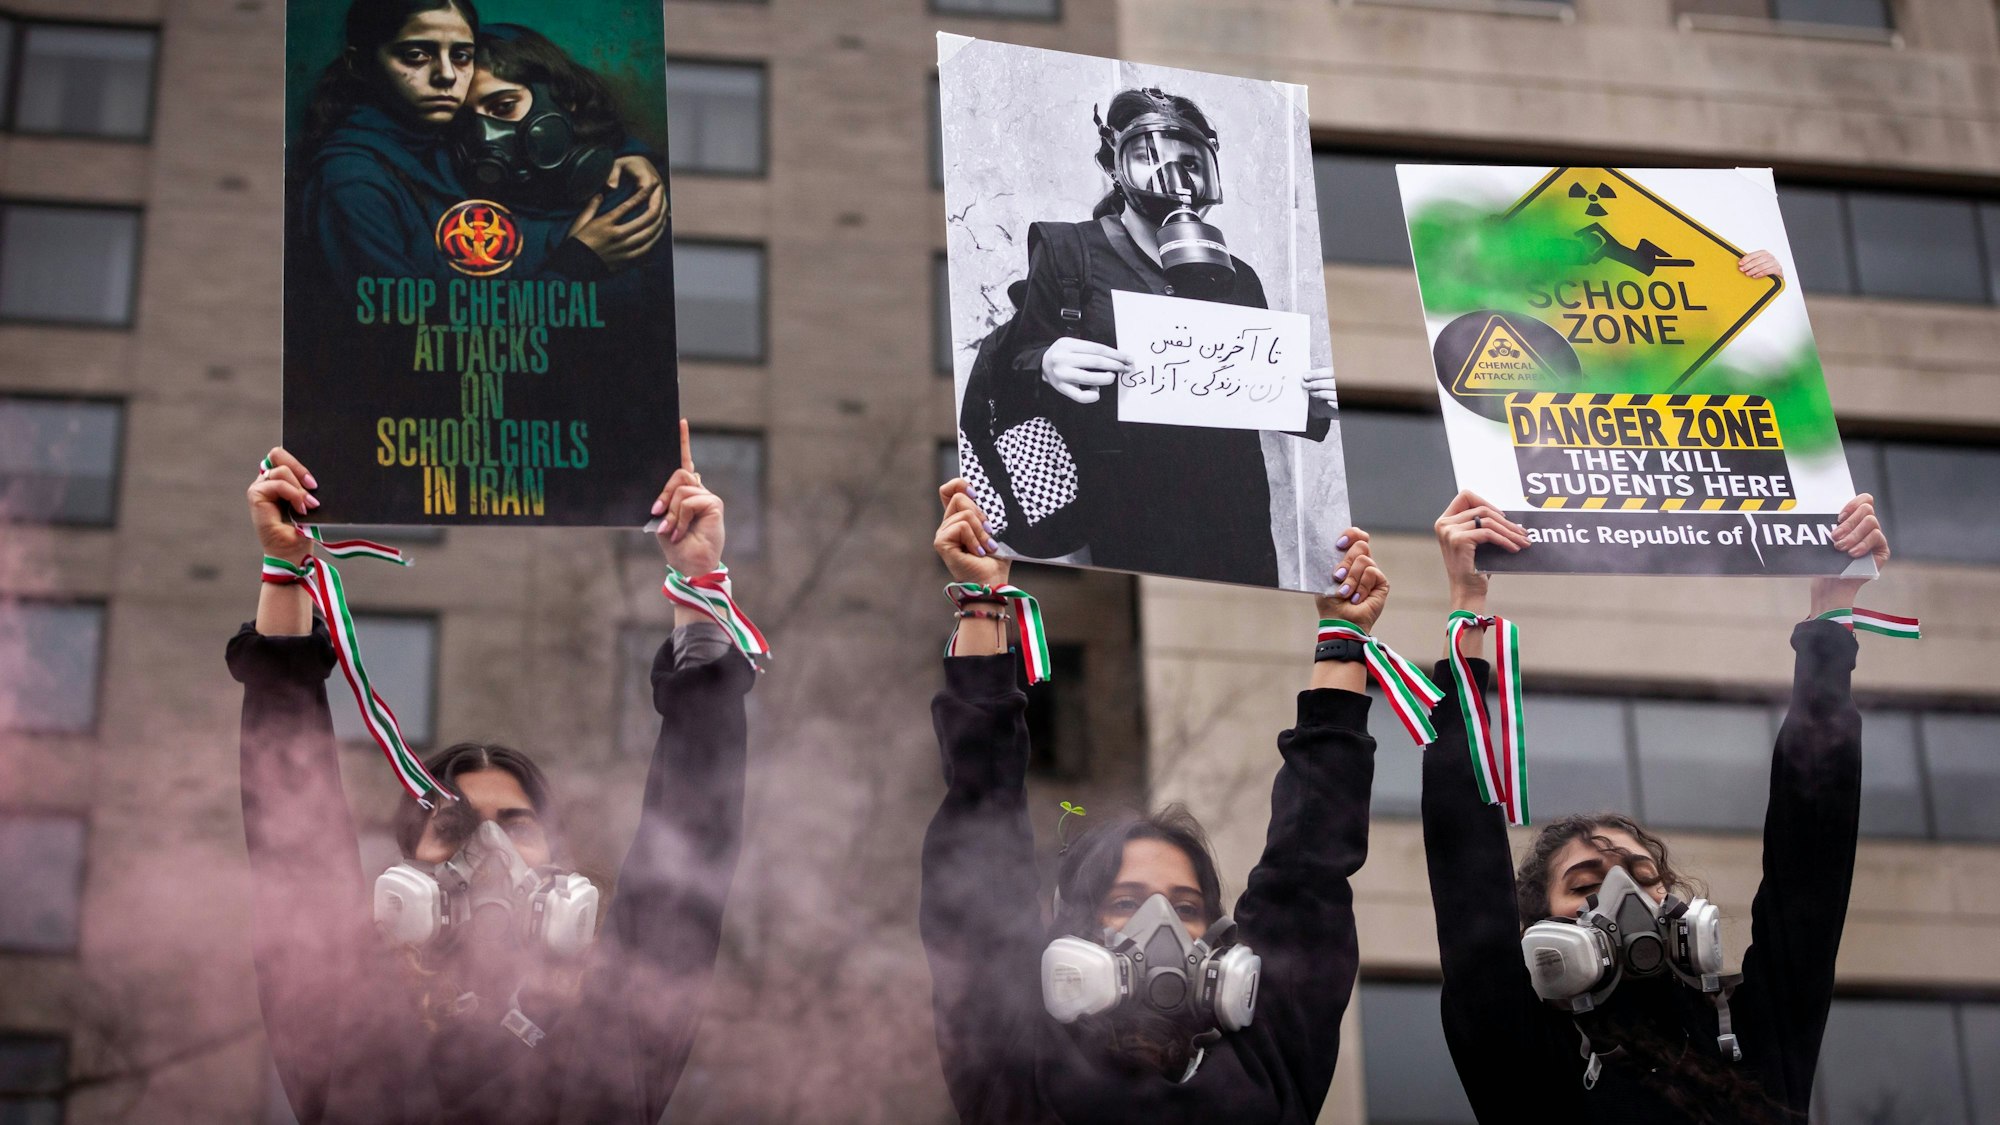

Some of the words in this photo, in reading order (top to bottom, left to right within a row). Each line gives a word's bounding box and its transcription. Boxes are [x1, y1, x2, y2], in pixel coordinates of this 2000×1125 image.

[357, 276, 436, 325] STOP
[449, 278, 606, 328] CHEMICAL
[1526, 280, 1708, 311] SCHOOL
[1199, 327, 1272, 363] آخرین
[1562, 313, 1685, 345] ZONE
[413, 325, 549, 374] ATTACKS
[1268, 336, 1283, 365] تا
[1478, 361, 1535, 370] CHEMICAL
[1474, 372, 1515, 381] ATTACK
[461, 371, 504, 420] ON
[376, 417, 590, 469] SCHOOLGIRLS
[1510, 406, 1669, 447] DANGER
[1672, 408, 1779, 448] ZONE
[1563, 449, 1648, 472] THEY
[1660, 451, 1731, 473] KILL
[423, 466, 457, 516] IN
[469, 466, 545, 516] IRAN
[1526, 472, 1695, 497] STUDENTS
[1702, 475, 1790, 497] HERE
[1596, 525, 1712, 549] Republic
[1717, 525, 1744, 546] of
